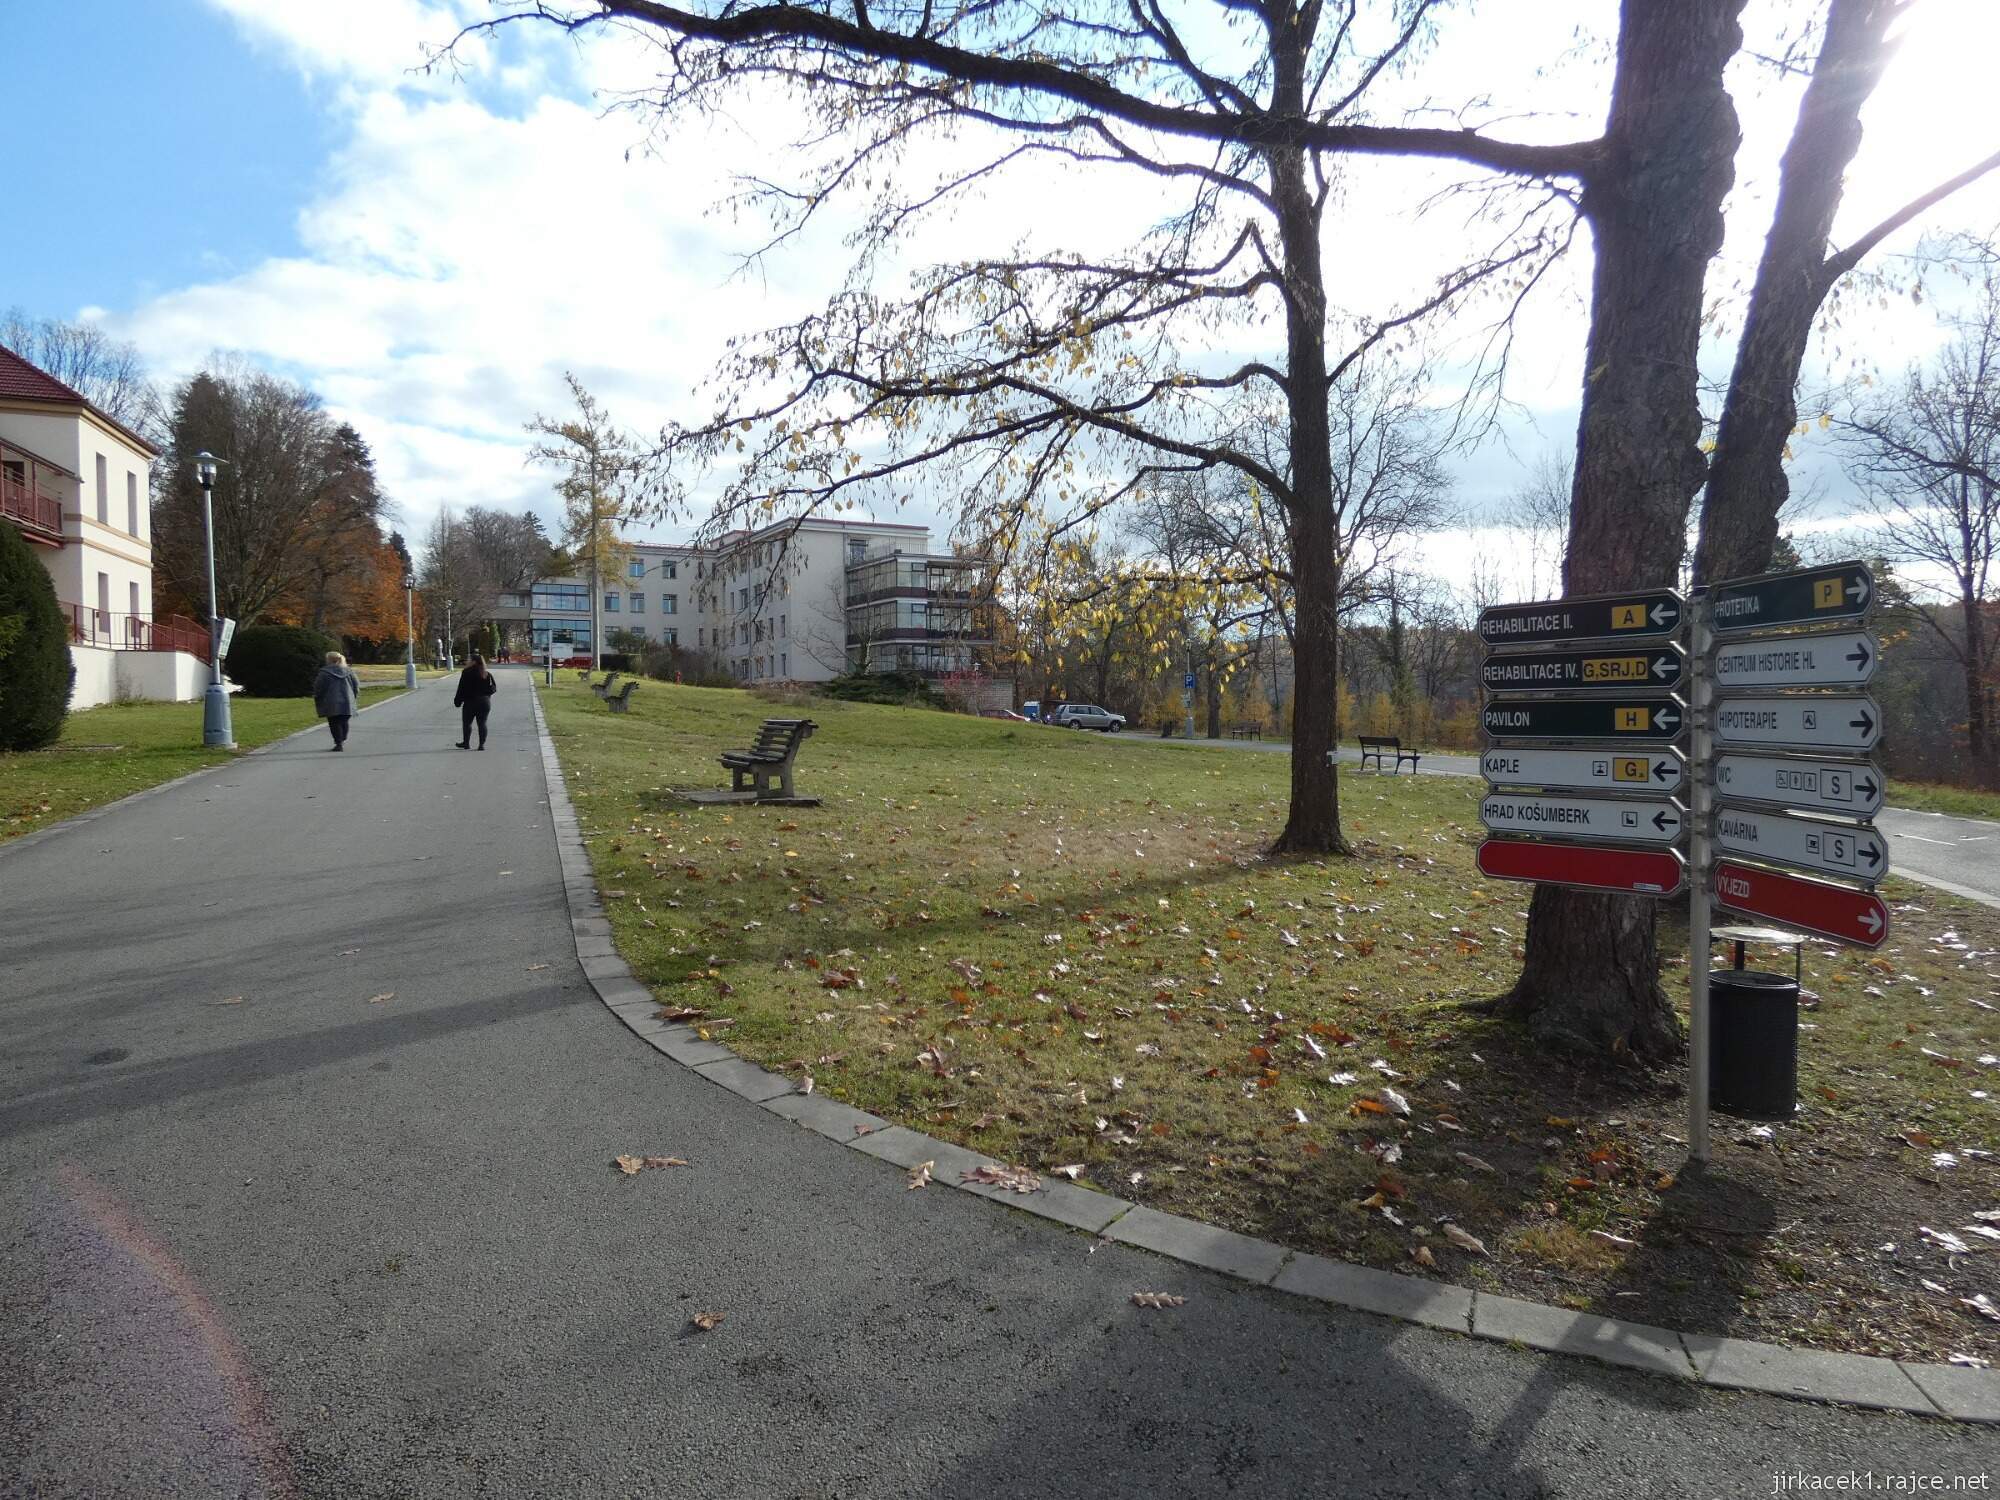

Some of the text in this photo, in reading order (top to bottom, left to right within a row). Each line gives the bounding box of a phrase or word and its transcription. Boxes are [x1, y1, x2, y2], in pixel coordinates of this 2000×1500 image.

[1714, 584, 1833, 618] PROTETIKA P
[1481, 609, 1635, 635] REHABILITACE II. A
[1483, 663, 1562, 681] REHABILITACE
[1565, 663, 1579, 678] IV.
[1717, 650, 1816, 674] CENTRUM HISTORIE HL
[1485, 711, 1637, 727] PAVILON H
[1719, 711, 1777, 730] HIPOTERAPIE
[1485, 758, 1520, 774] KAPLE
[1717, 766, 1841, 795] WC S
[1484, 802, 1590, 824] HRAD KOŠUMBERK
[1717, 818, 1844, 859] KAVÁRNA S
[1717, 871, 1750, 898] VÝJEZD
